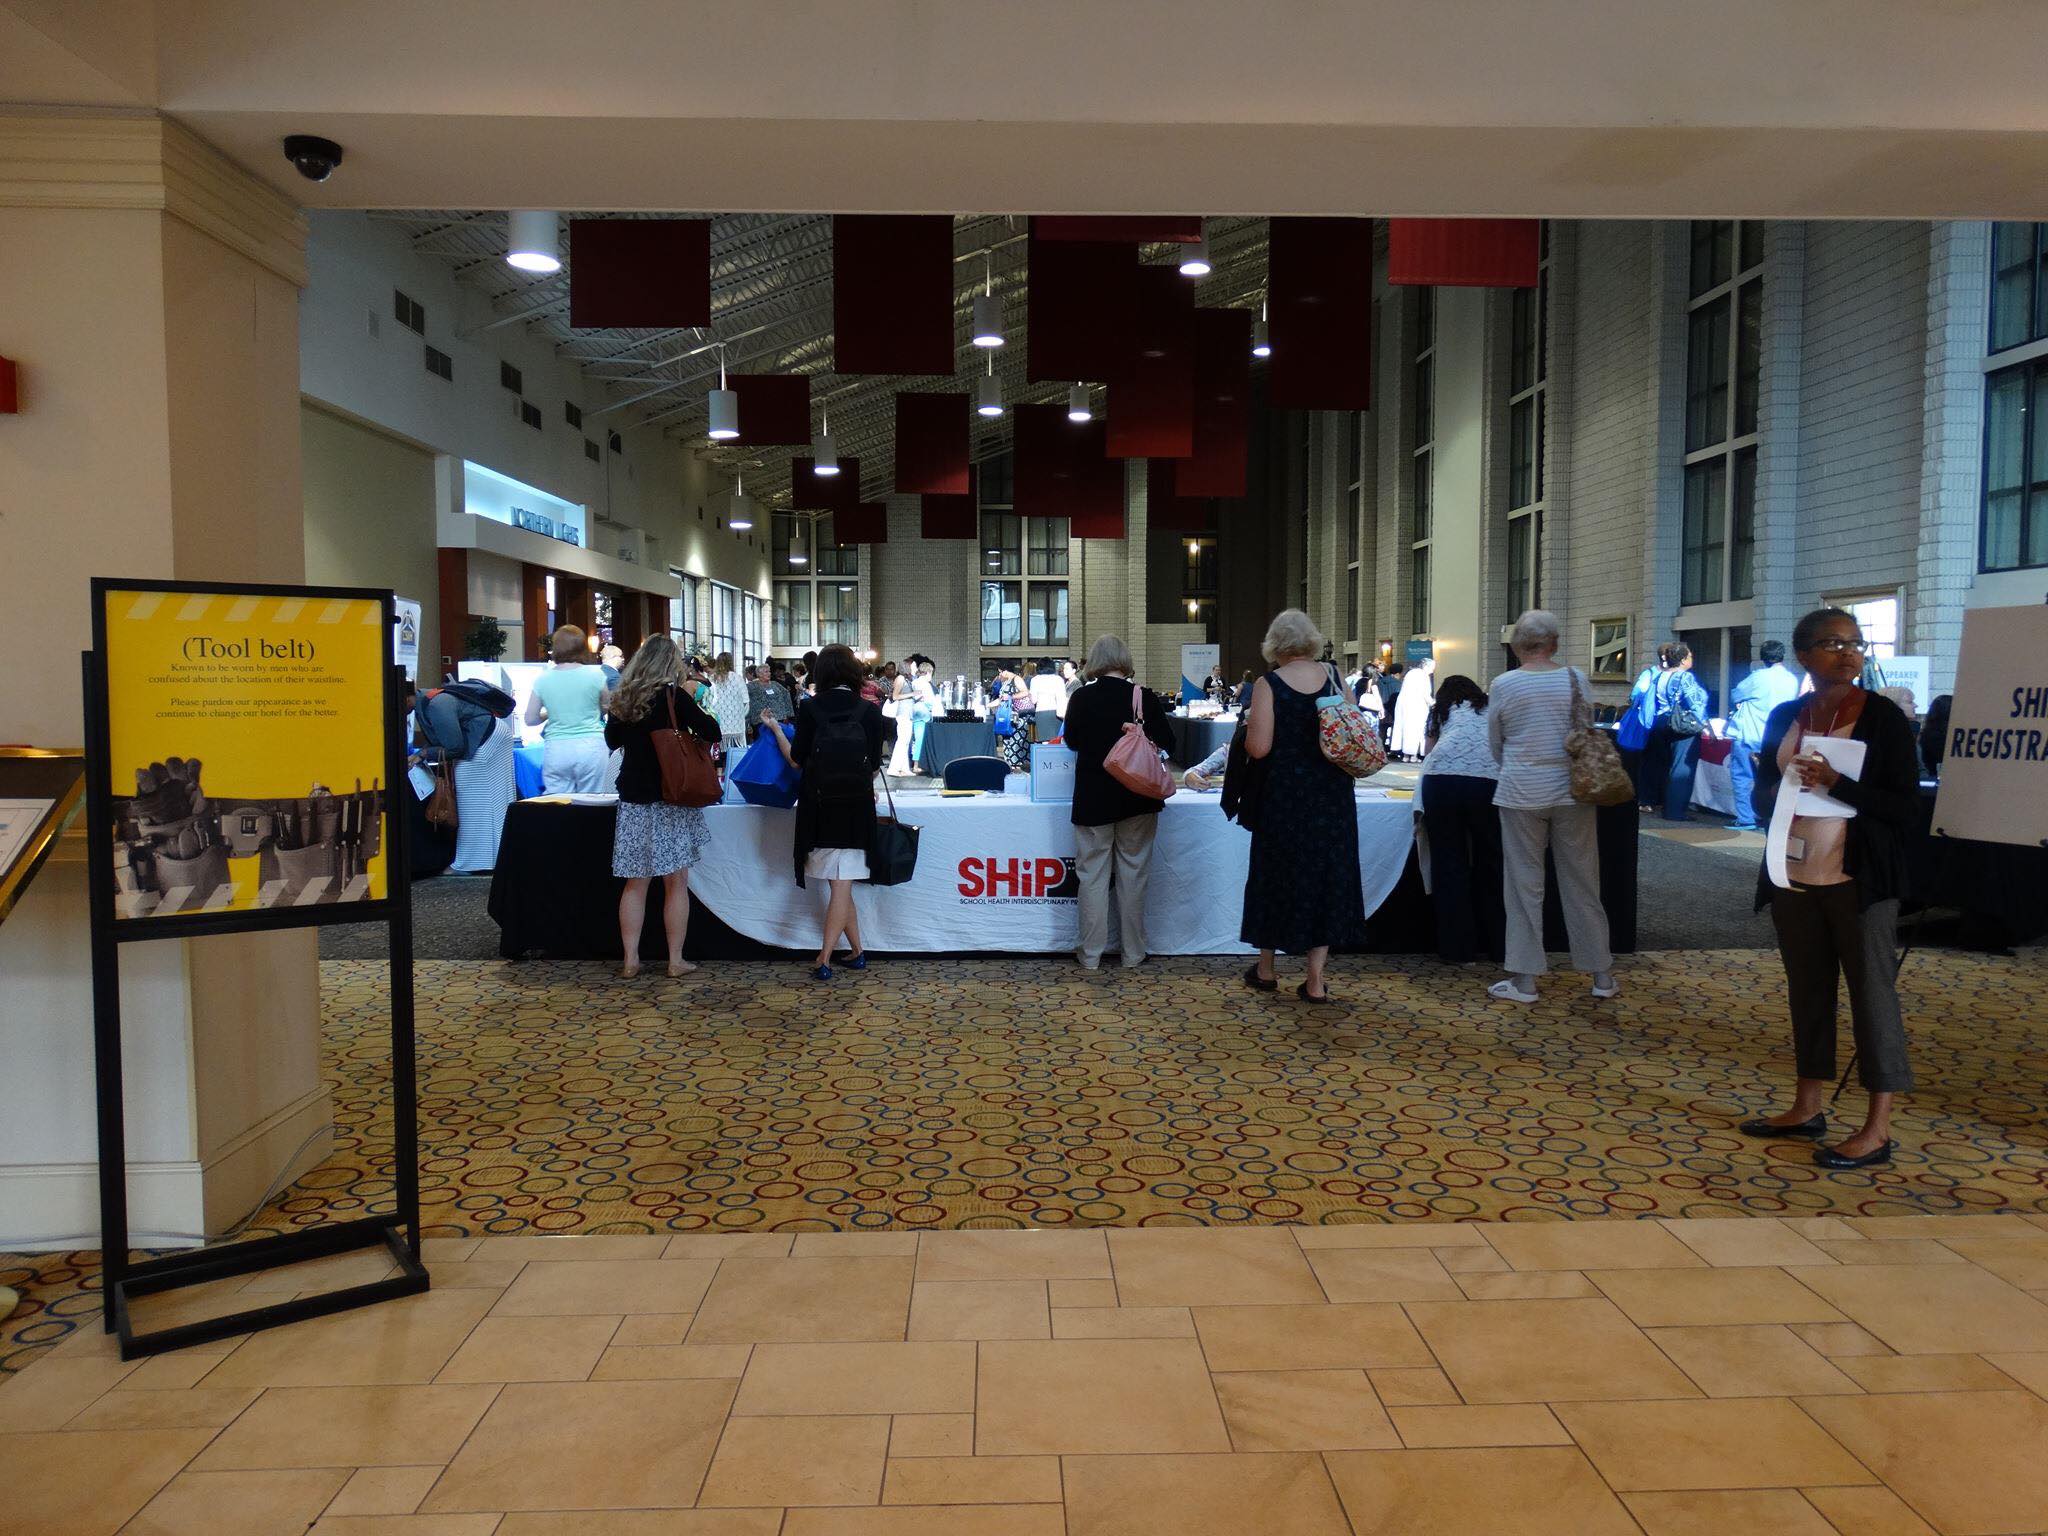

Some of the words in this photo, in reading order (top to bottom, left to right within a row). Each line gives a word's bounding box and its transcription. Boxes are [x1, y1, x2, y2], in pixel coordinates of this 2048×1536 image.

[182, 637, 250, 661] (Tool
[260, 638, 315, 662] belt)
[171, 663, 205, 672] Known
[207, 664, 216, 672] to
[218, 663, 229, 672] be
[256, 664, 267, 674] by
[291, 664, 309, 673] who
[311, 665, 324, 673] are
[148, 675, 190, 683] confused
[193, 675, 218, 683] about
[220, 675, 233, 683] the
[237, 675, 272, 684] location
[273, 675, 283, 683] of
[285, 675, 304, 683] their
[1885, 671, 1919, 679] SPEAKER
[171, 698, 200, 706] Please
[202, 698, 233, 707] pardon
[253, 699, 300, 707] appearance
[155, 709, 195, 718] continue
[209, 709, 241, 719] change
[260, 709, 282, 717] hotel
[284, 709, 297, 717] for
[299, 709, 312, 717] the
[1042, 761, 1052, 770] M
[1063, 761, 1070, 770] S
